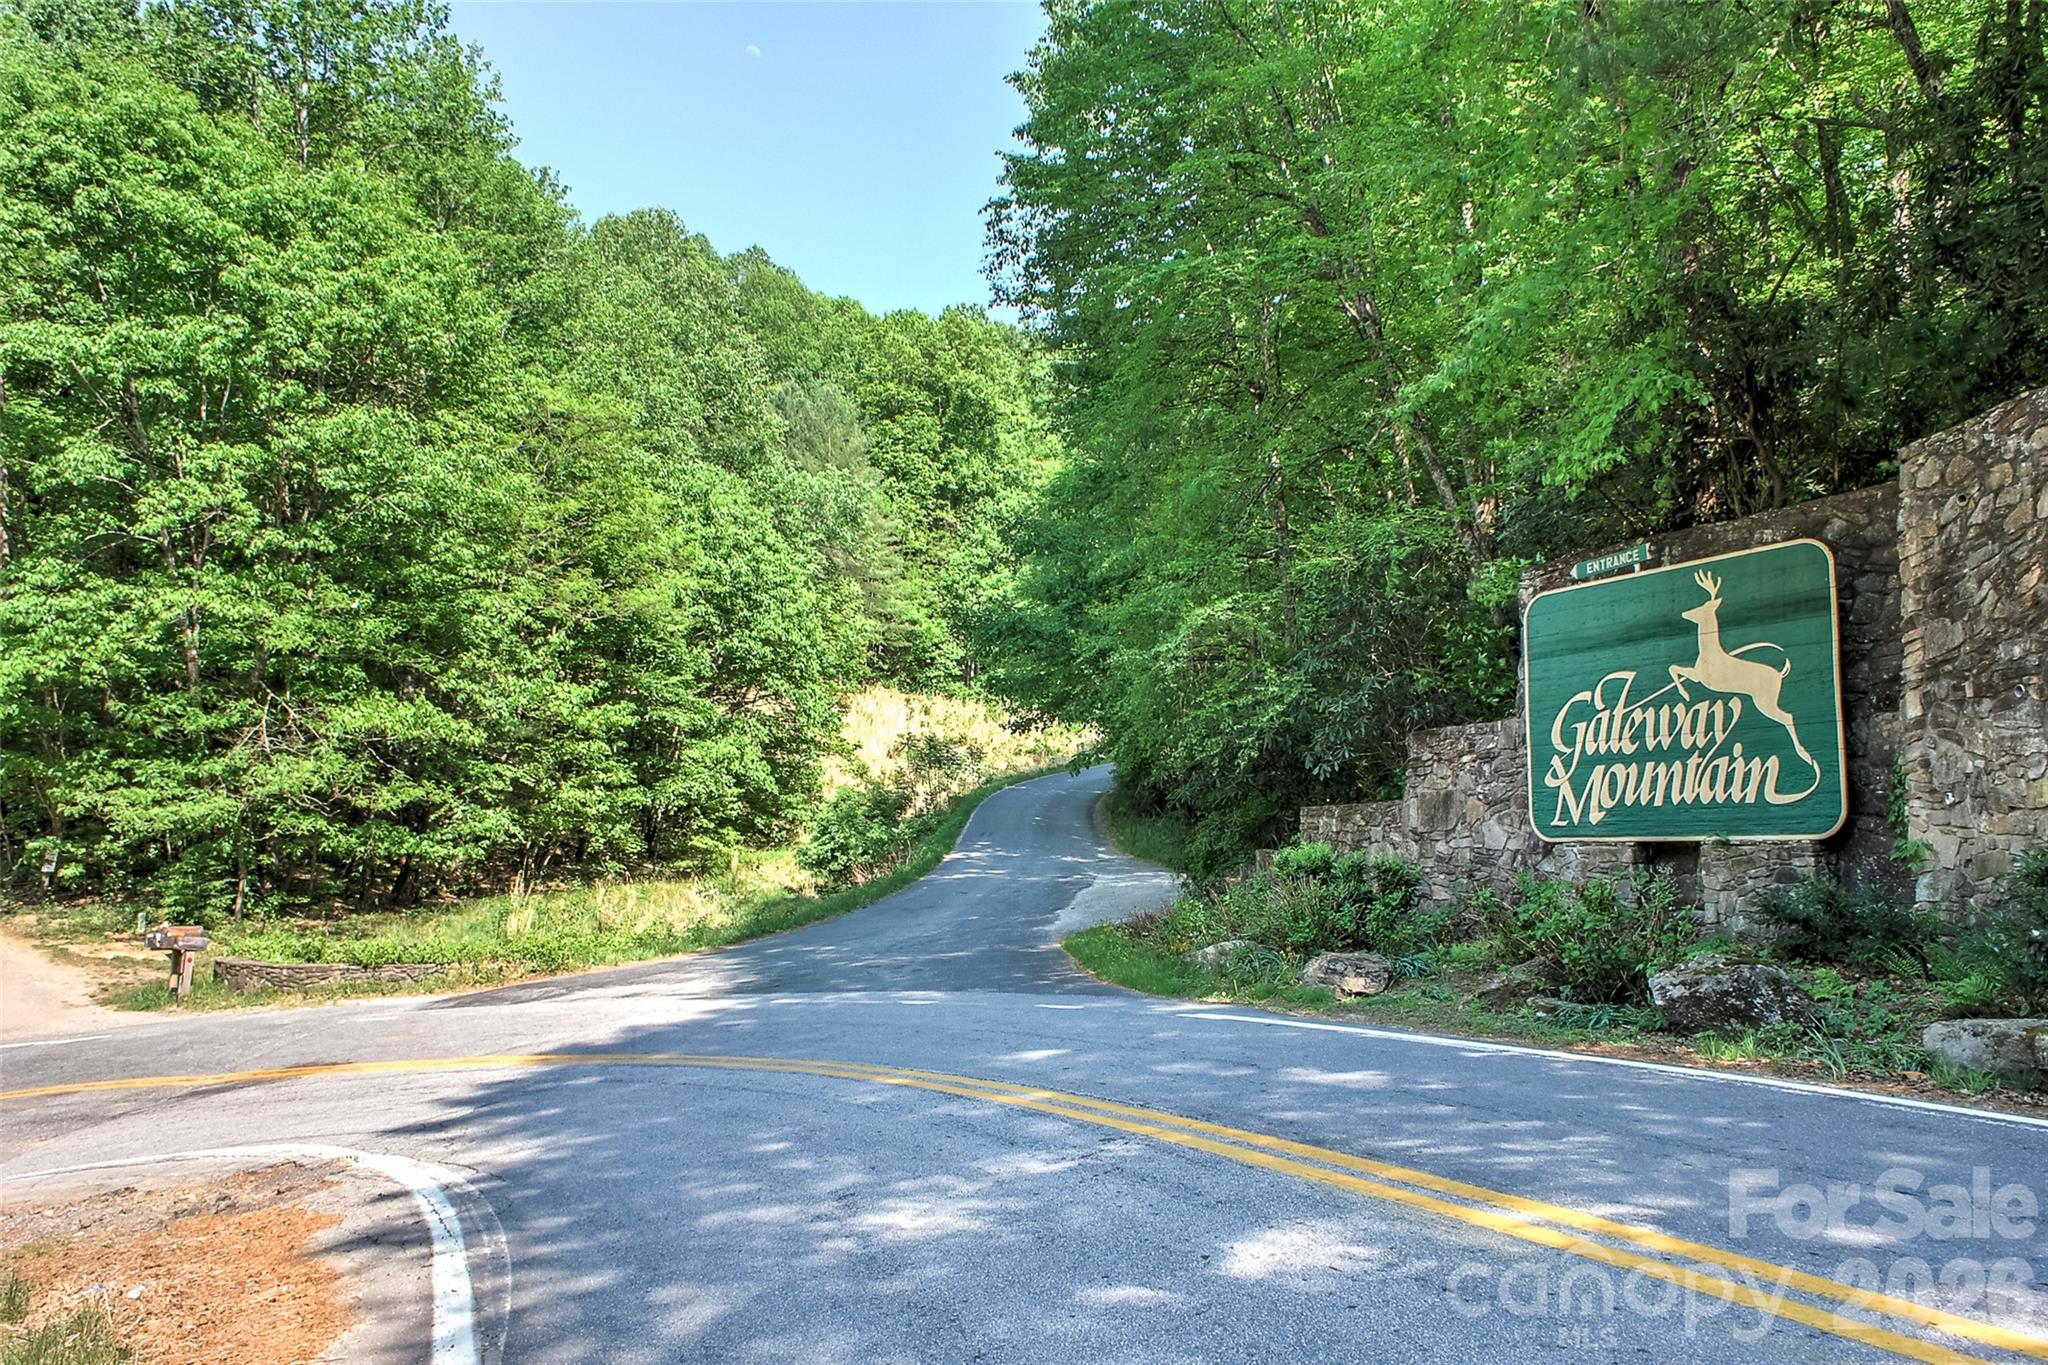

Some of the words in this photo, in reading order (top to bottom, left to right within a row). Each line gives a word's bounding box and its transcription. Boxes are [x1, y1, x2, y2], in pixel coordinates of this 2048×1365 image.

[1586, 549, 1640, 574] ENTRANCE
[1547, 671, 1743, 787] Gateway
[1549, 743, 1821, 826] Mountain
